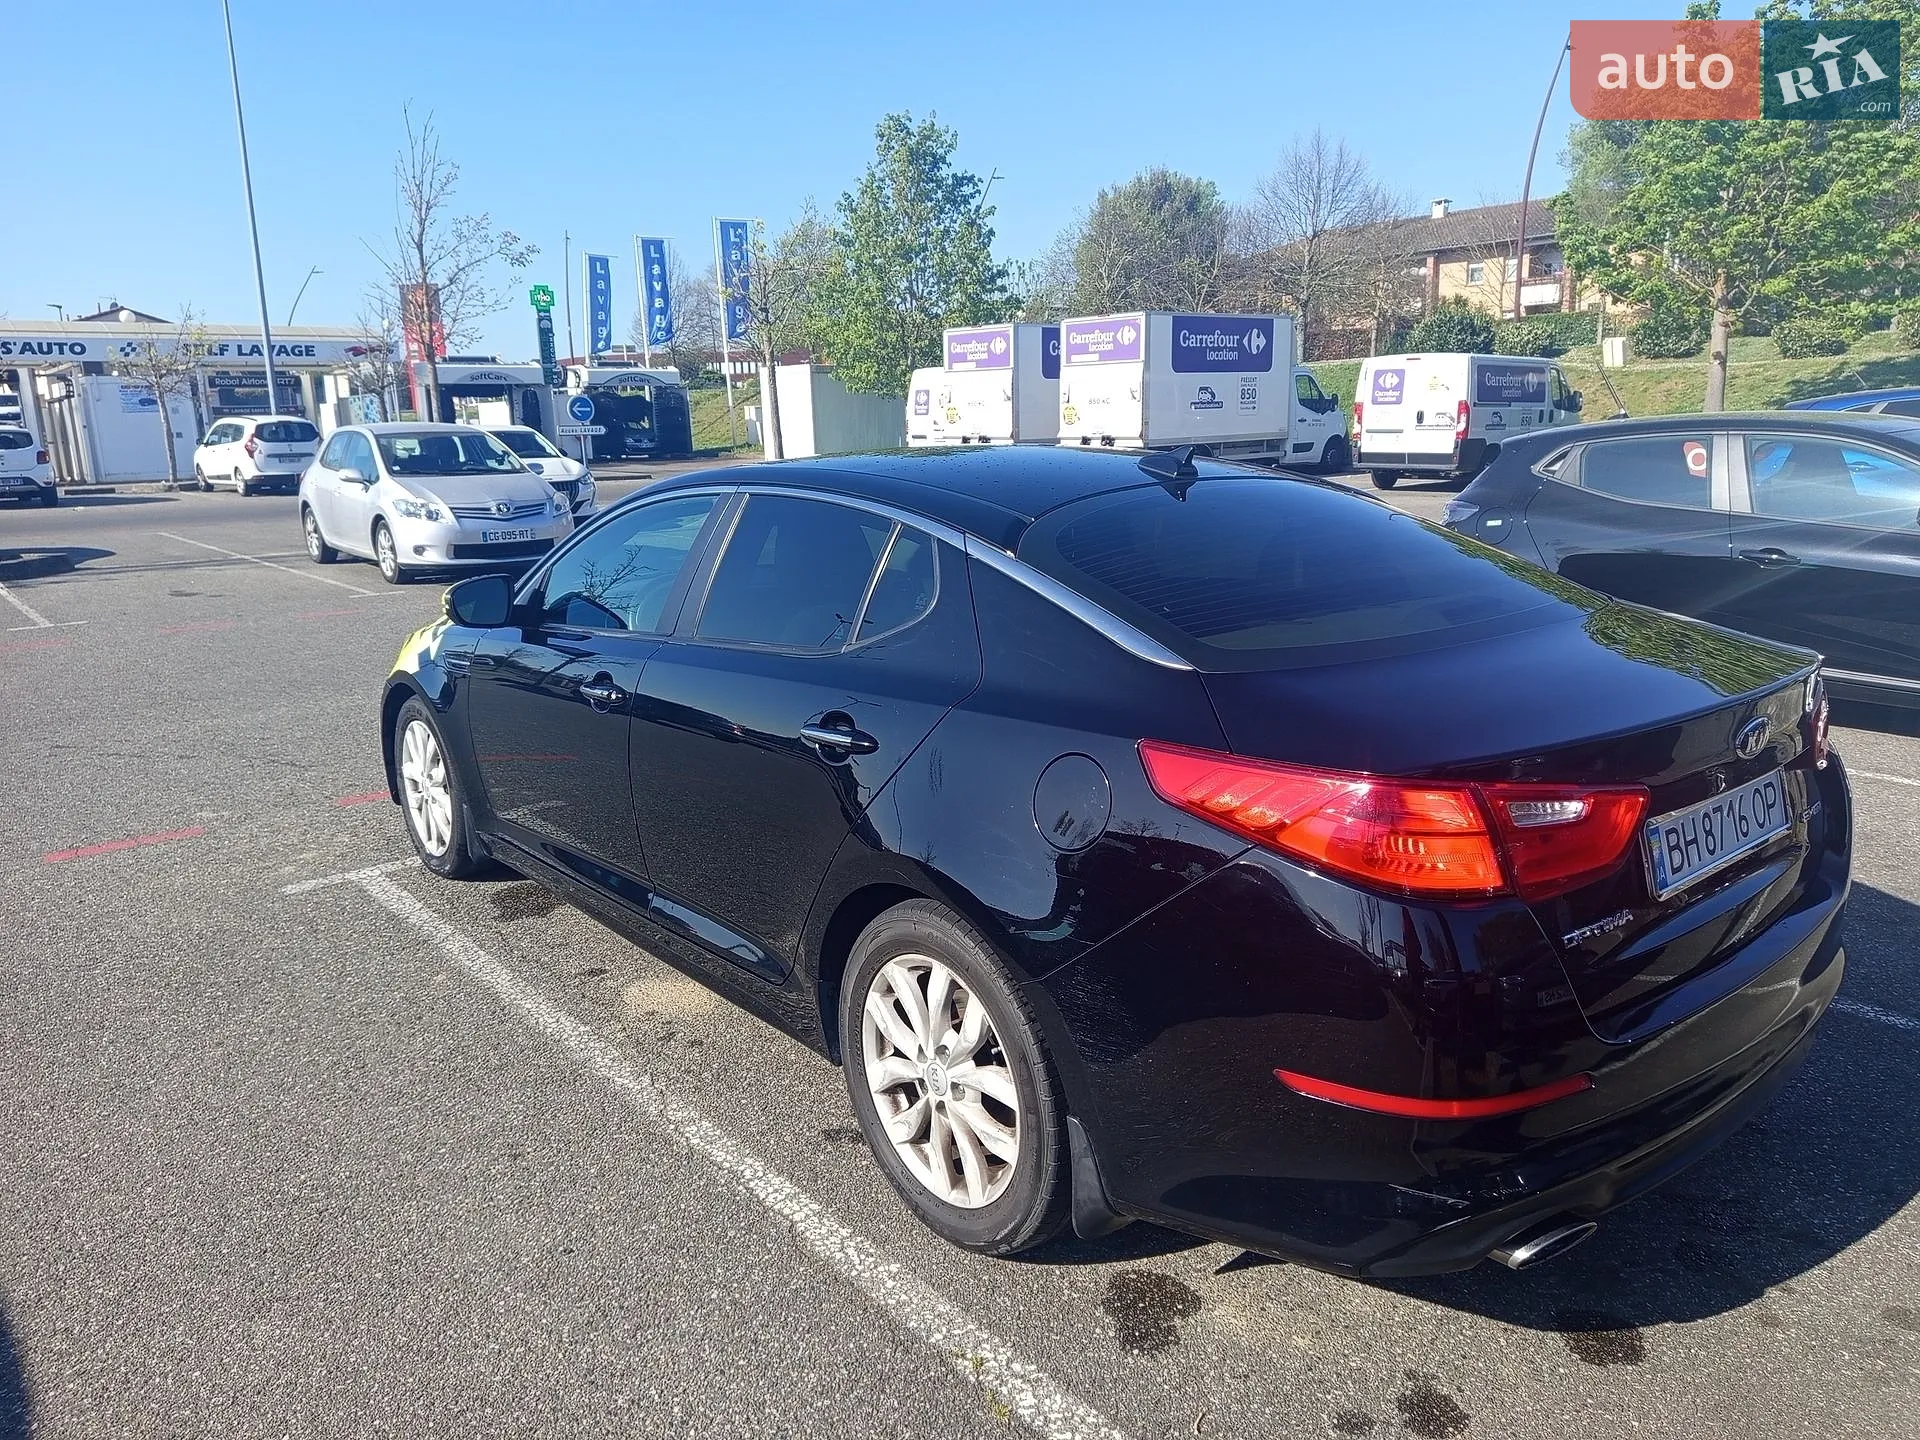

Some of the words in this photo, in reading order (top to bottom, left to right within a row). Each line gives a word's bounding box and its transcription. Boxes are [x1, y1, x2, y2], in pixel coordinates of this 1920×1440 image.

[650, 244, 666, 340] Lavage
[595, 261, 607, 350] Lavage
[1069, 325, 1116, 344] Carrefour
[1179, 329, 1240, 348] Carrefour
[950, 340, 989, 354] Carrefour
[1206, 348, 1239, 361] location
[1485, 371, 1522, 387] Carrefour
[1240, 387, 1257, 400] 850
[1664, 817, 1702, 876] BH
[1701, 794, 1750, 857] 8716
[1751, 781, 1777, 830] OP
[931, 1066, 941, 1091] KIA
